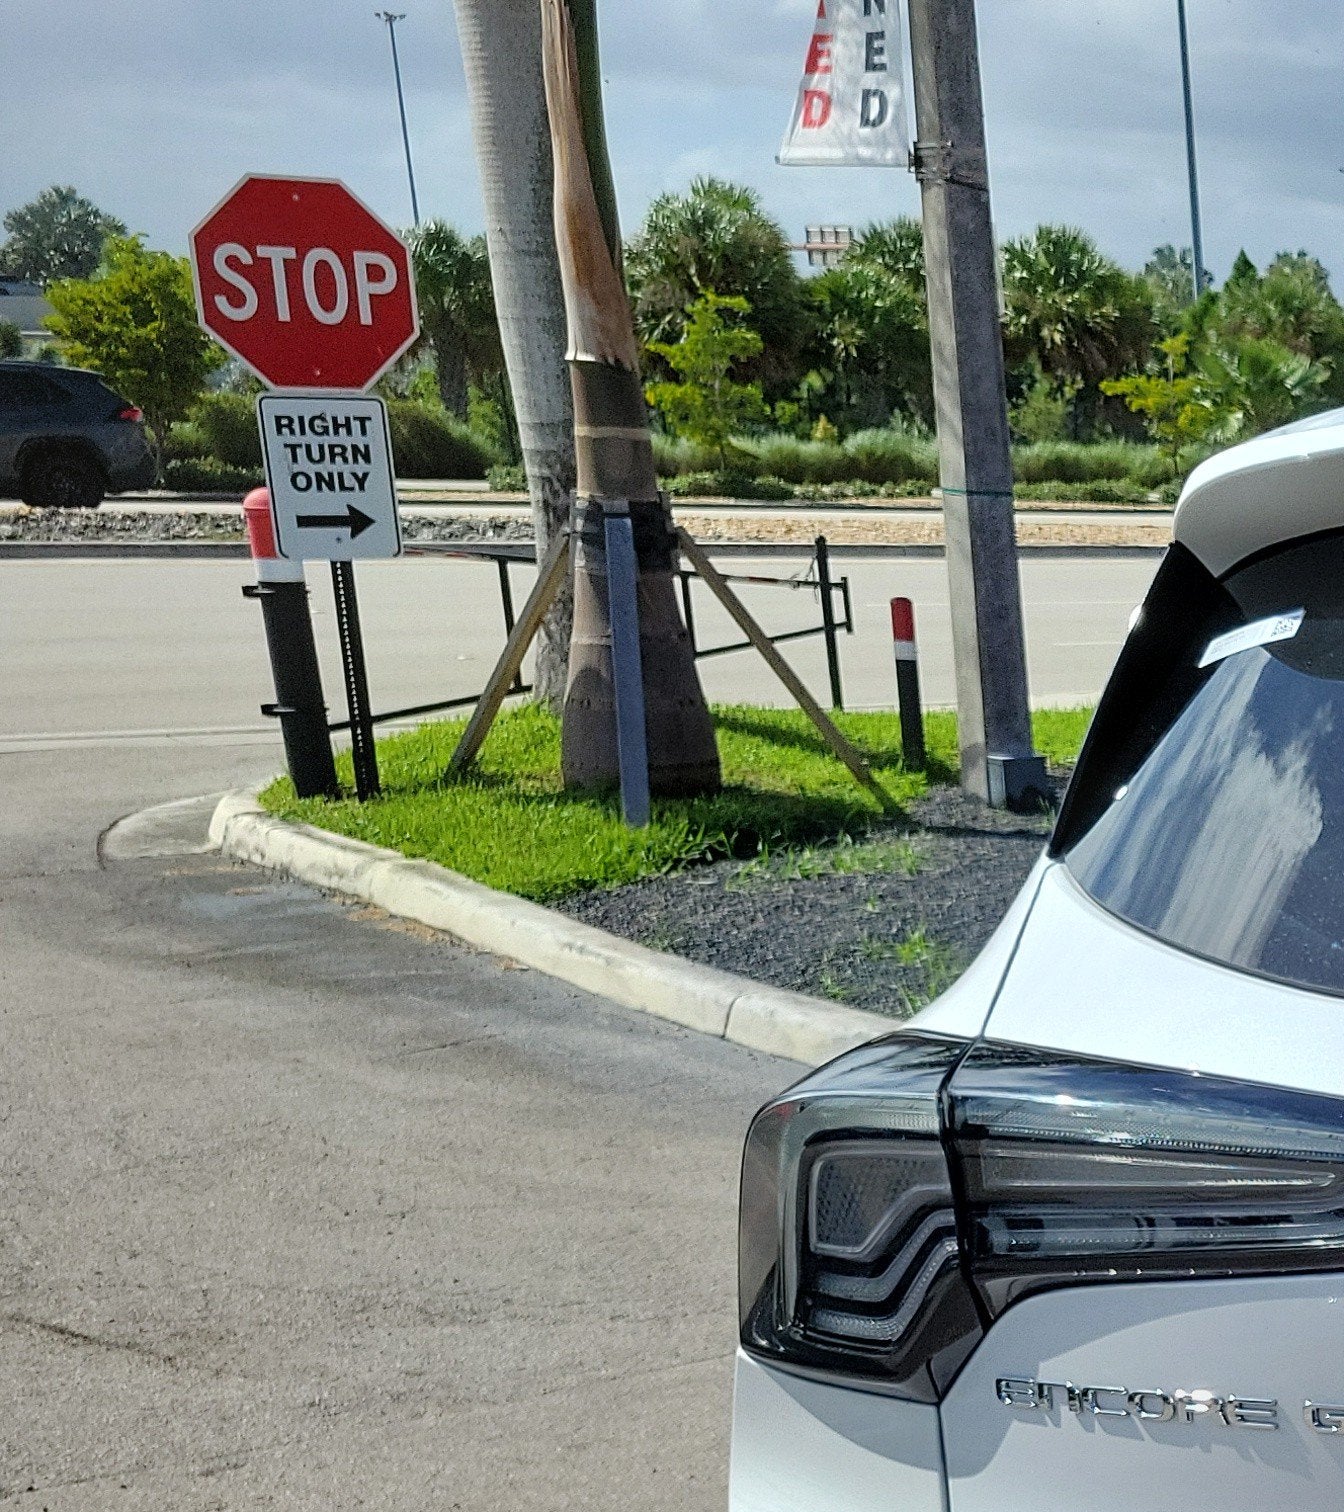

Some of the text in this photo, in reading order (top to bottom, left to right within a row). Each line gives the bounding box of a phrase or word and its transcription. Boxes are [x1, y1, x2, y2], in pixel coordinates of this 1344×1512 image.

[212, 242, 398, 326] STOP
[274, 413, 372, 438] RIGHT
[282, 440, 372, 466] TURN
[289, 469, 371, 494] ONLY
[995, 1377, 1279, 1431] ENCORE
